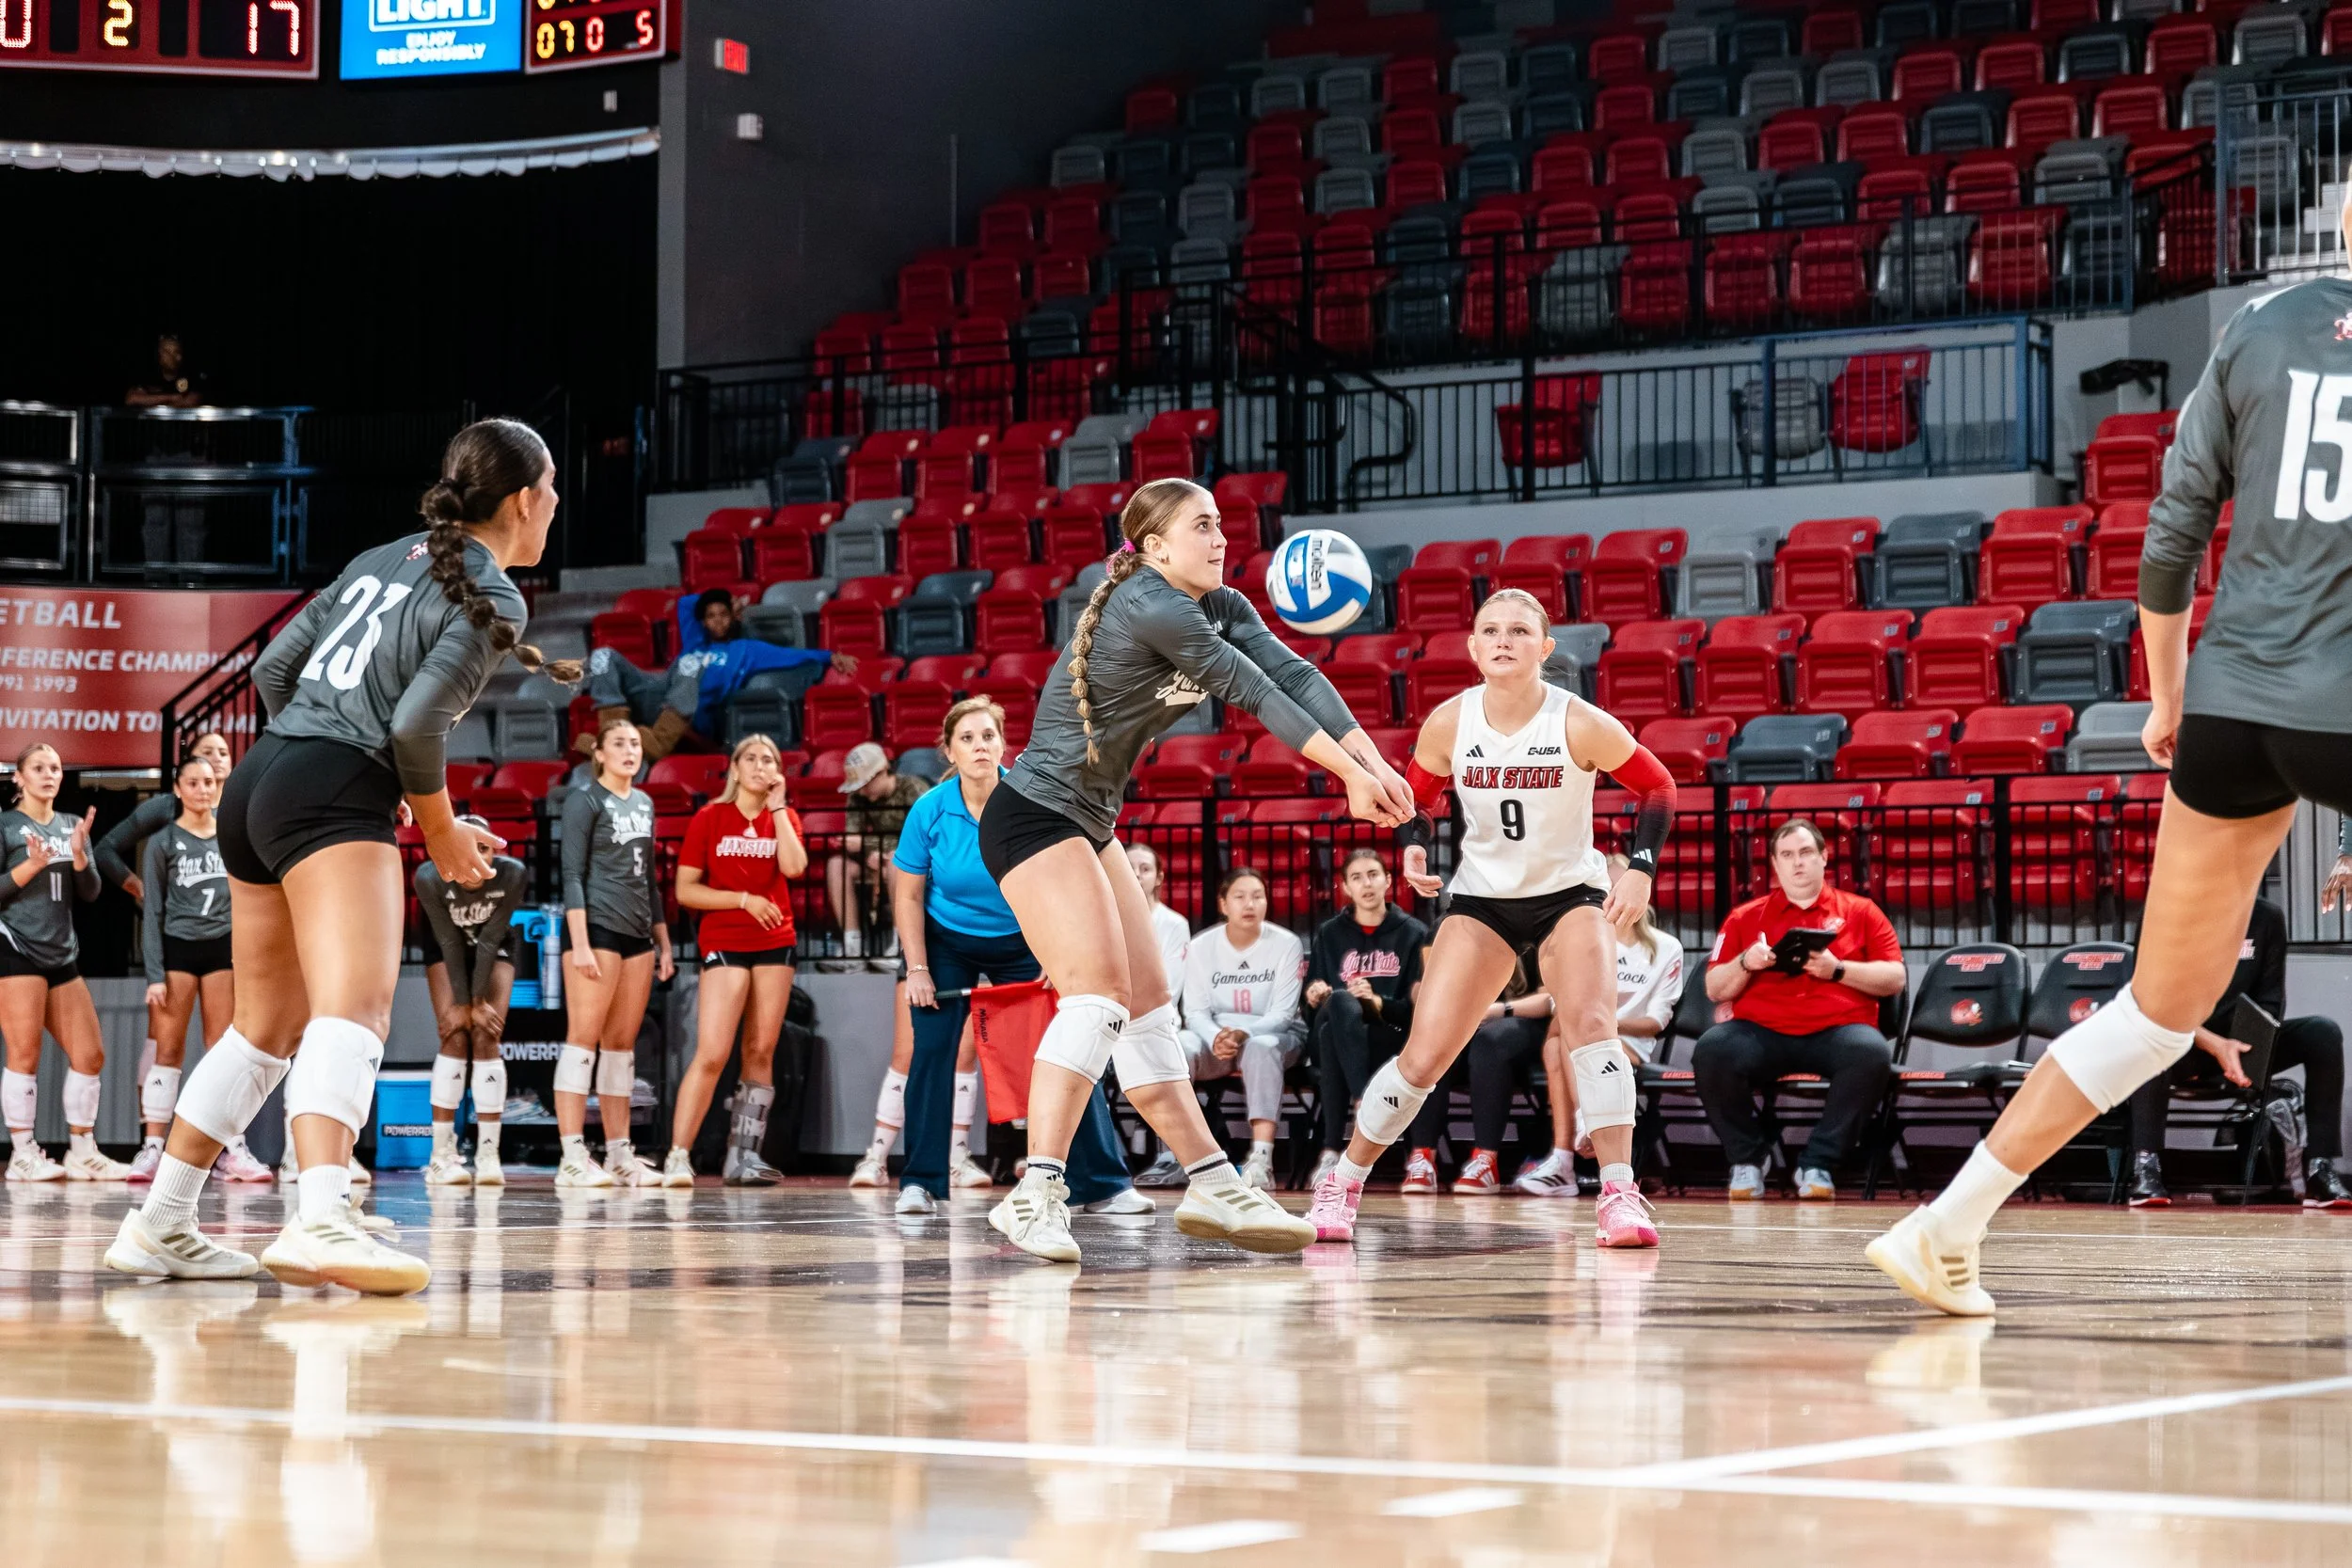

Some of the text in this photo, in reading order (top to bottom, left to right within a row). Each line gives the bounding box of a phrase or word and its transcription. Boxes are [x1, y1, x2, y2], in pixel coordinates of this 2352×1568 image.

[104, 0, 132, 47] 2
[247, 0, 299, 55] 17
[2274, 368, 2352, 523] 15
[299, 575, 413, 690] 23
[0, 646, 115, 671] FERENCE
[0, 707, 120, 732] VITATION
[1462, 766, 1564, 789] JAX STATE
[1500, 799, 1526, 841] 9
[49, 871, 62, 902] 11
[200, 888, 215, 915] 7
